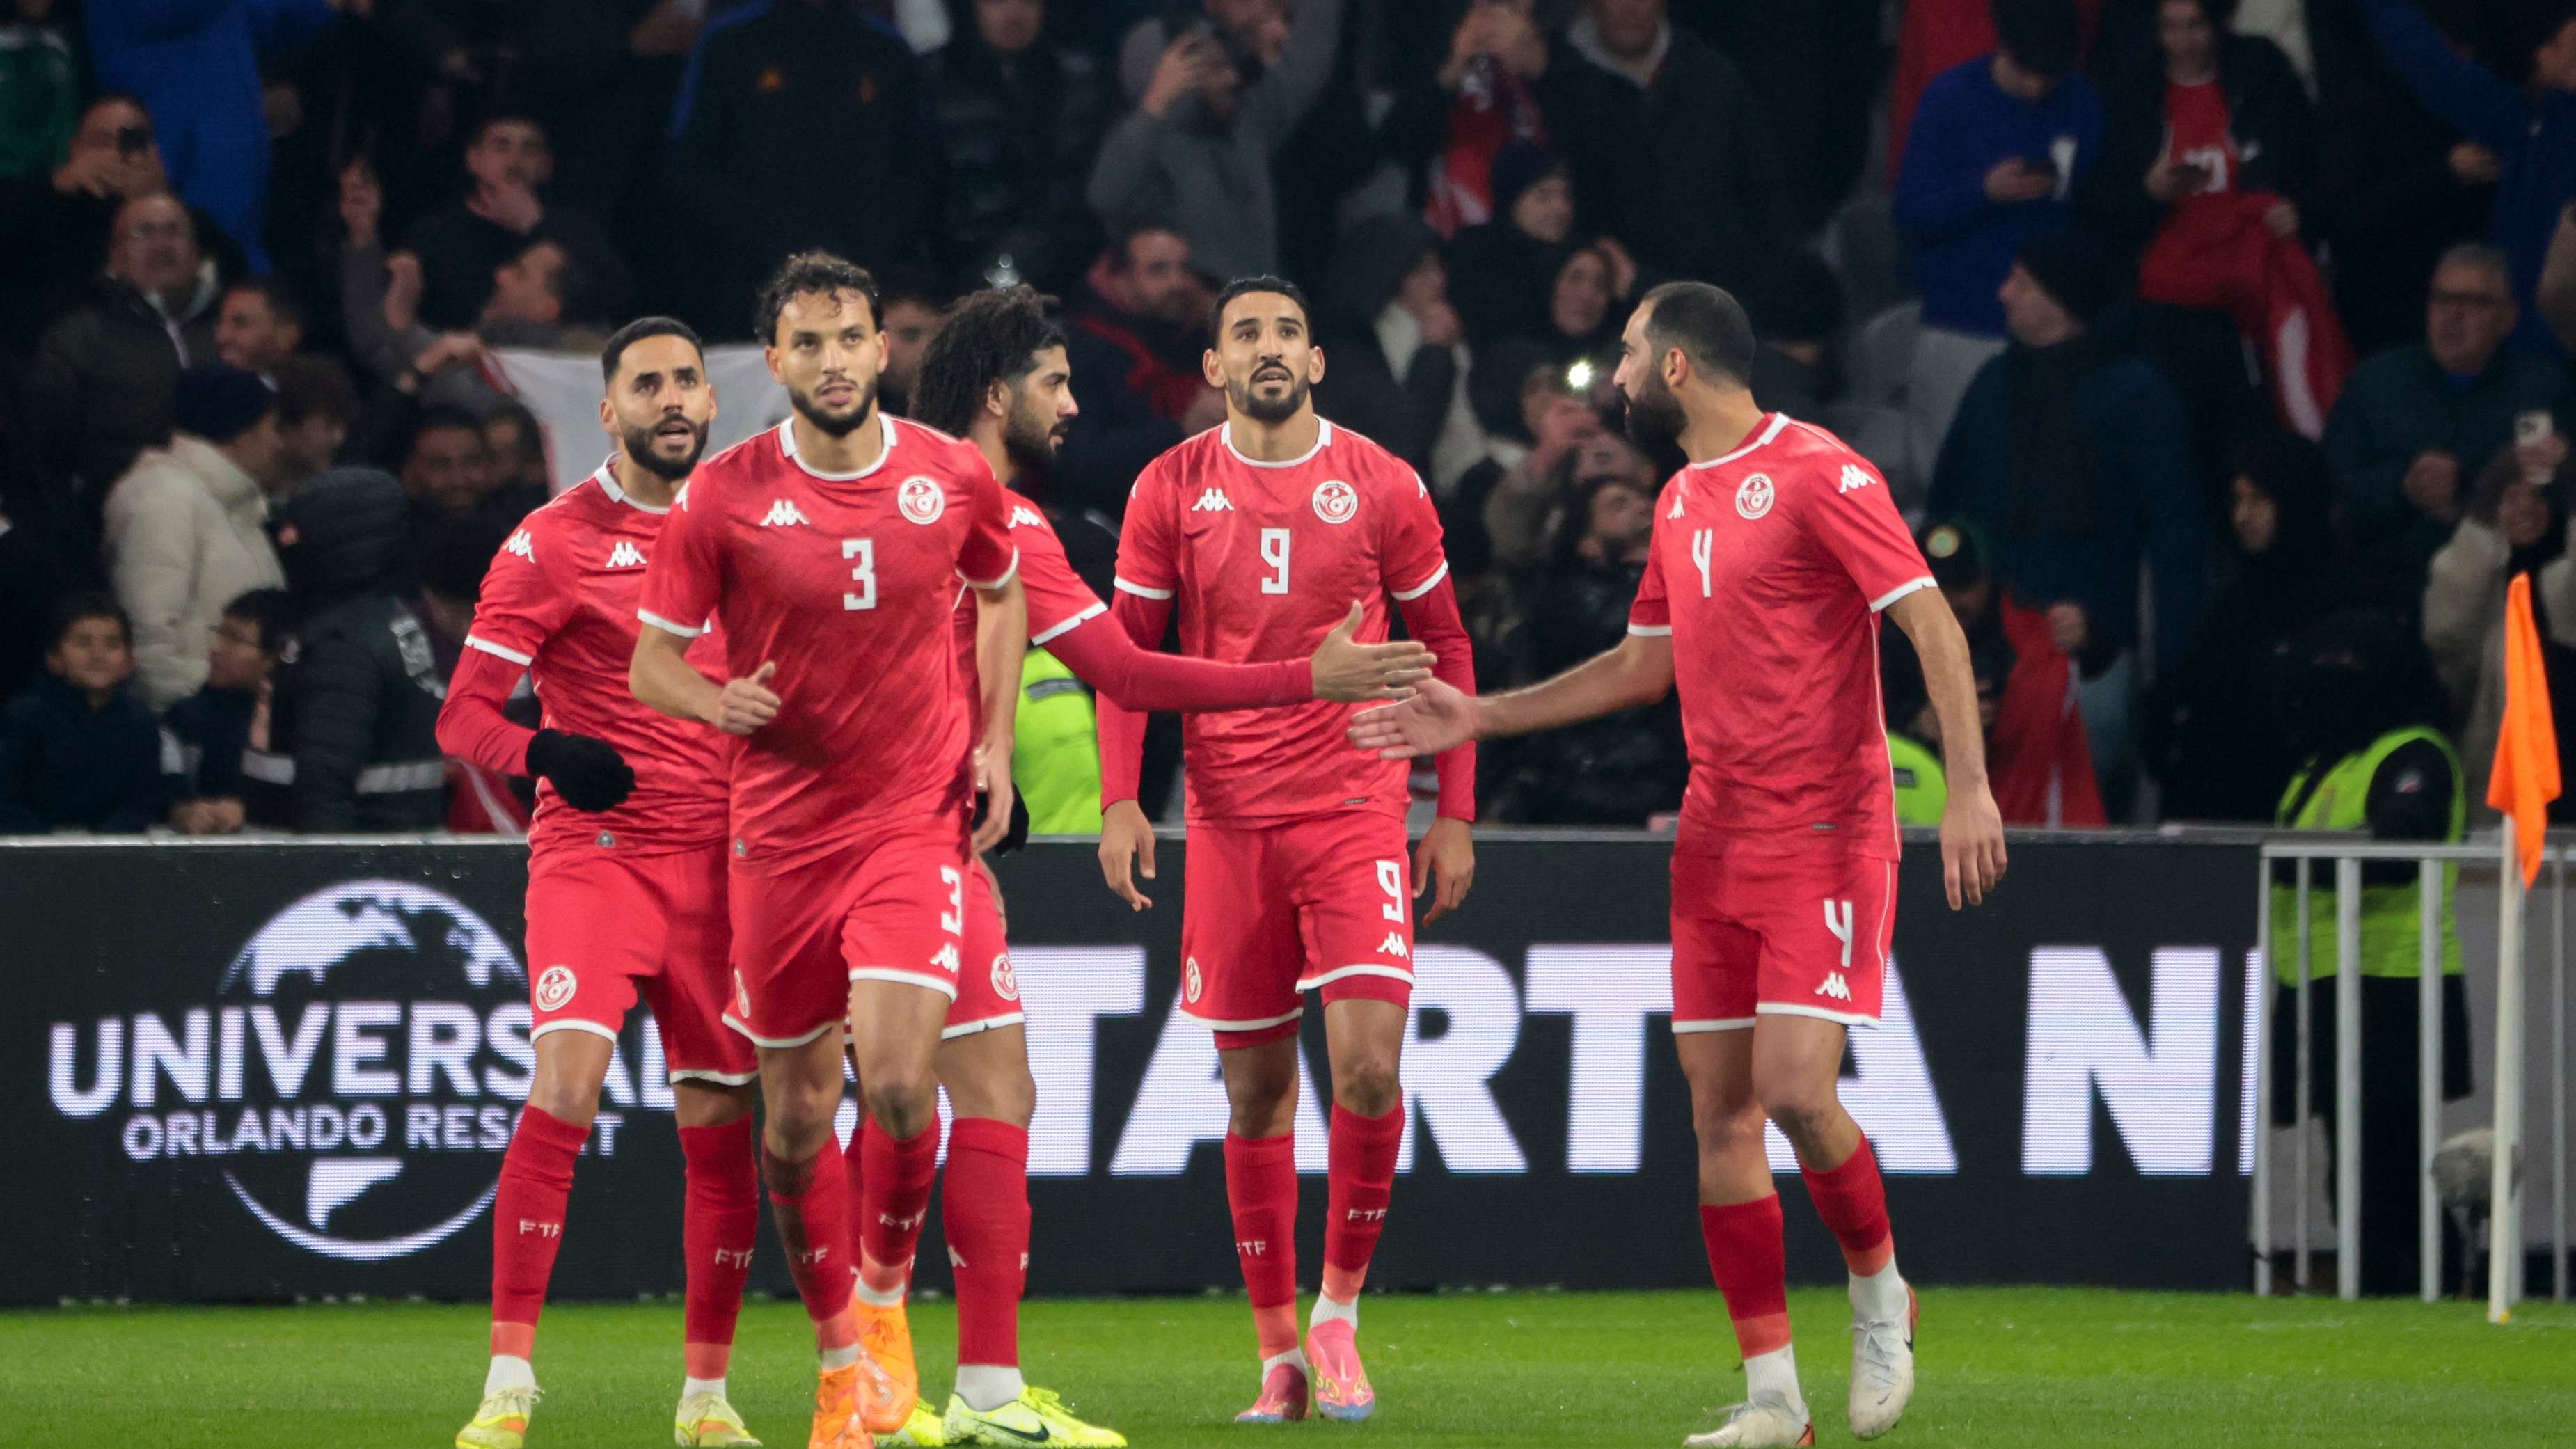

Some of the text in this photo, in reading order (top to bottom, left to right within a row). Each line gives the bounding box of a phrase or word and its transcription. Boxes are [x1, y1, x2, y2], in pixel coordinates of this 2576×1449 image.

[842, 539, 877, 611] 3
[1260, 528, 1290, 594] 9
[1692, 528, 1713, 598] 4
[940, 865, 963, 936] 3
[1375, 860, 1405, 925] 9
[1824, 898, 1854, 967] 4
[833, 945, 1674, 1176] TART
[2021, 944, 2262, 1176] N
[122, 1104, 625, 1162] ORLANDO REST
